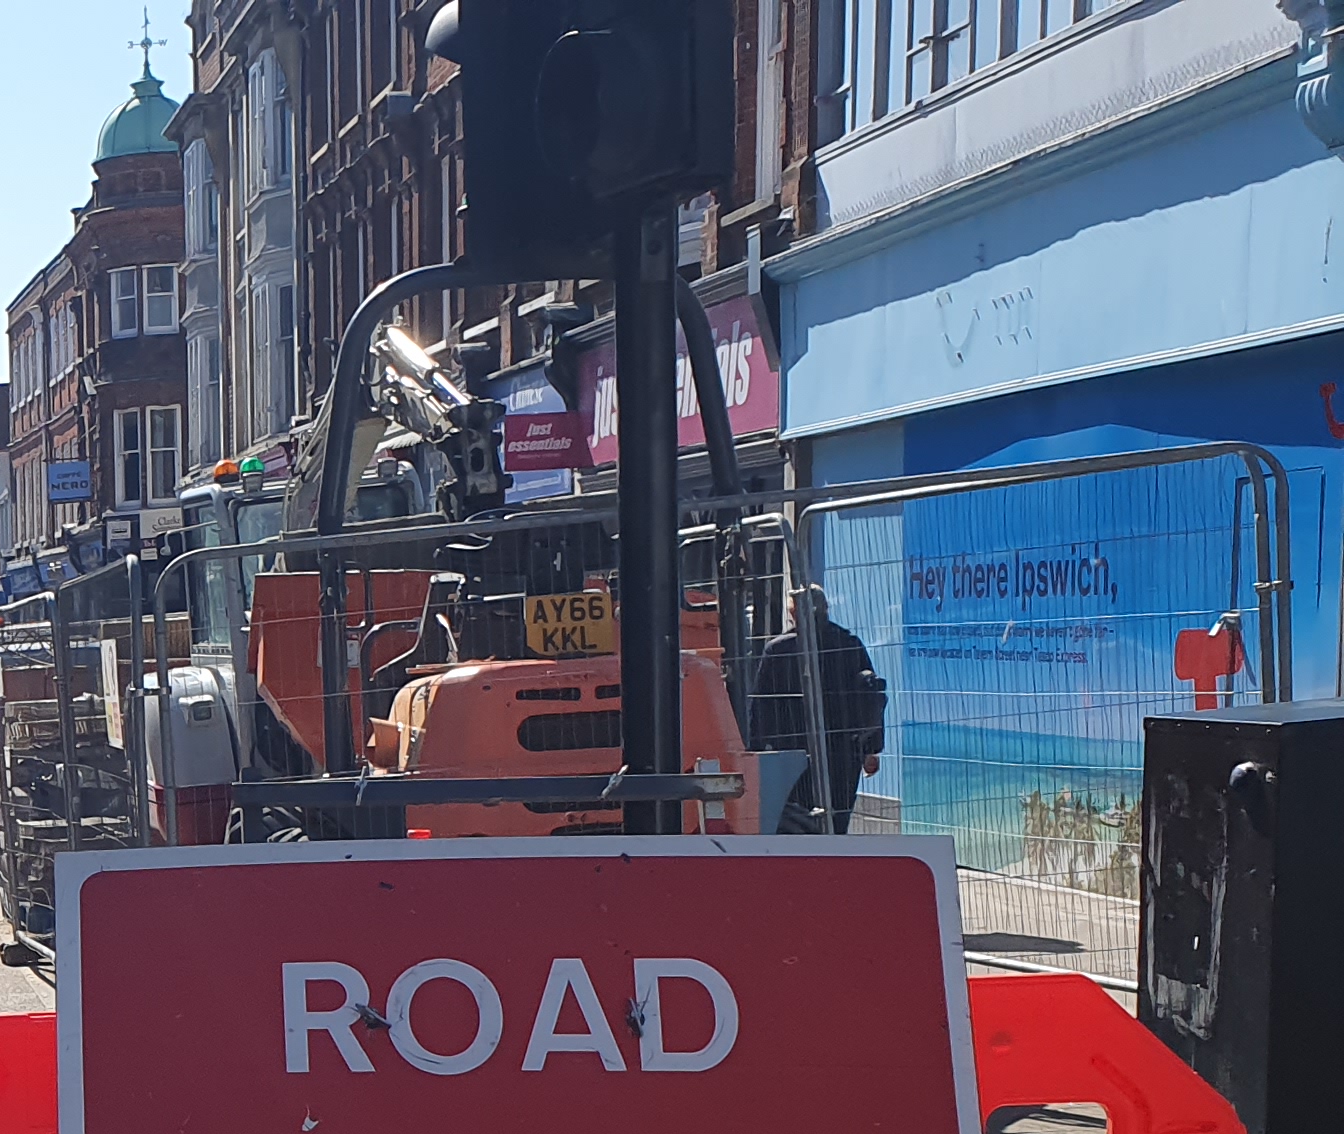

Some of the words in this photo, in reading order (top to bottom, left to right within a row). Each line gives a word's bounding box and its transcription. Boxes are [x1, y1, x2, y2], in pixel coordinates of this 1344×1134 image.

[508, 437, 572, 453] essentials
[51, 480, 89, 490] NERO
[910, 555, 946, 612] Hey
[952, 557, 1008, 599] there
[1015, 543, 1118, 612] Ipswich,
[533, 596, 604, 624] AY66
[542, 626, 597, 652] KKL
[281, 958, 739, 1075] ROAD
